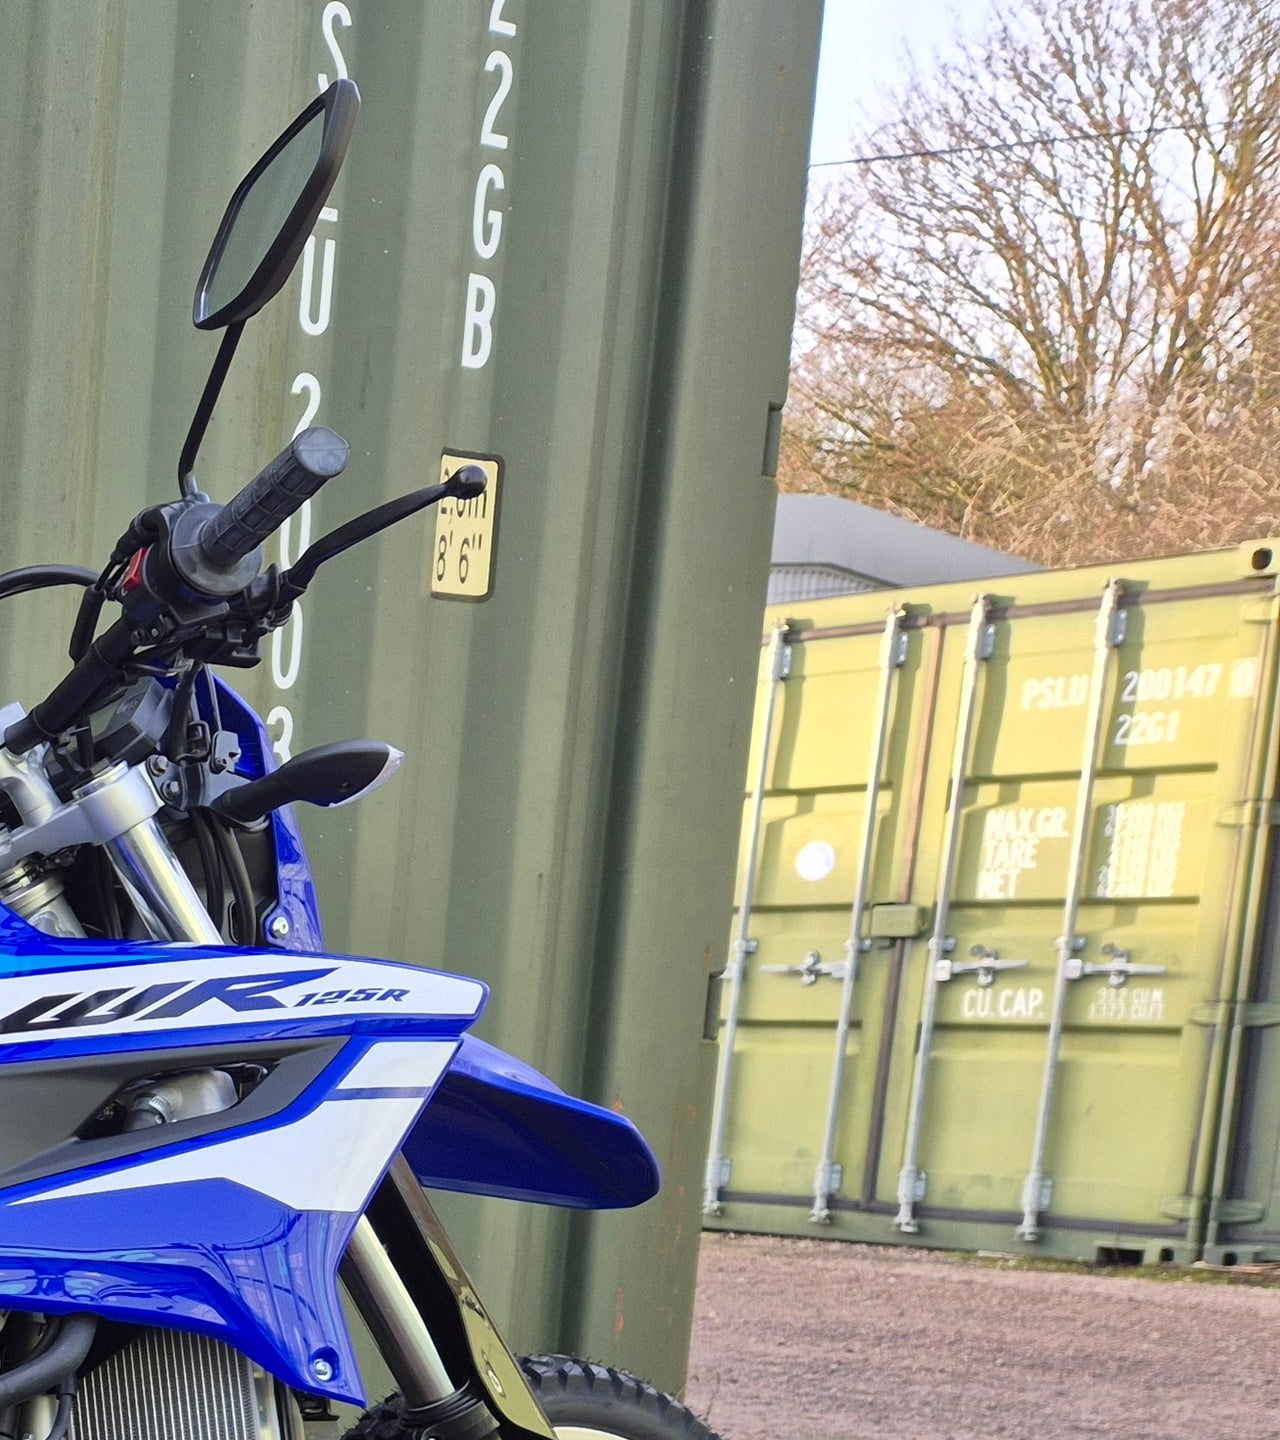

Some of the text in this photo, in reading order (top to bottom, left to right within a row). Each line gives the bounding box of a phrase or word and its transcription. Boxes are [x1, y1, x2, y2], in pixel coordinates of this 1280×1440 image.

[1020, 674, 1090, 711] PSLU
[1121, 663, 1224, 702] 200147
[1114, 710, 1181, 746] 22G1
[981, 837, 1040, 868] TARE
[976, 866, 1021, 899] NET
[292, 988, 412, 1008] 125R
